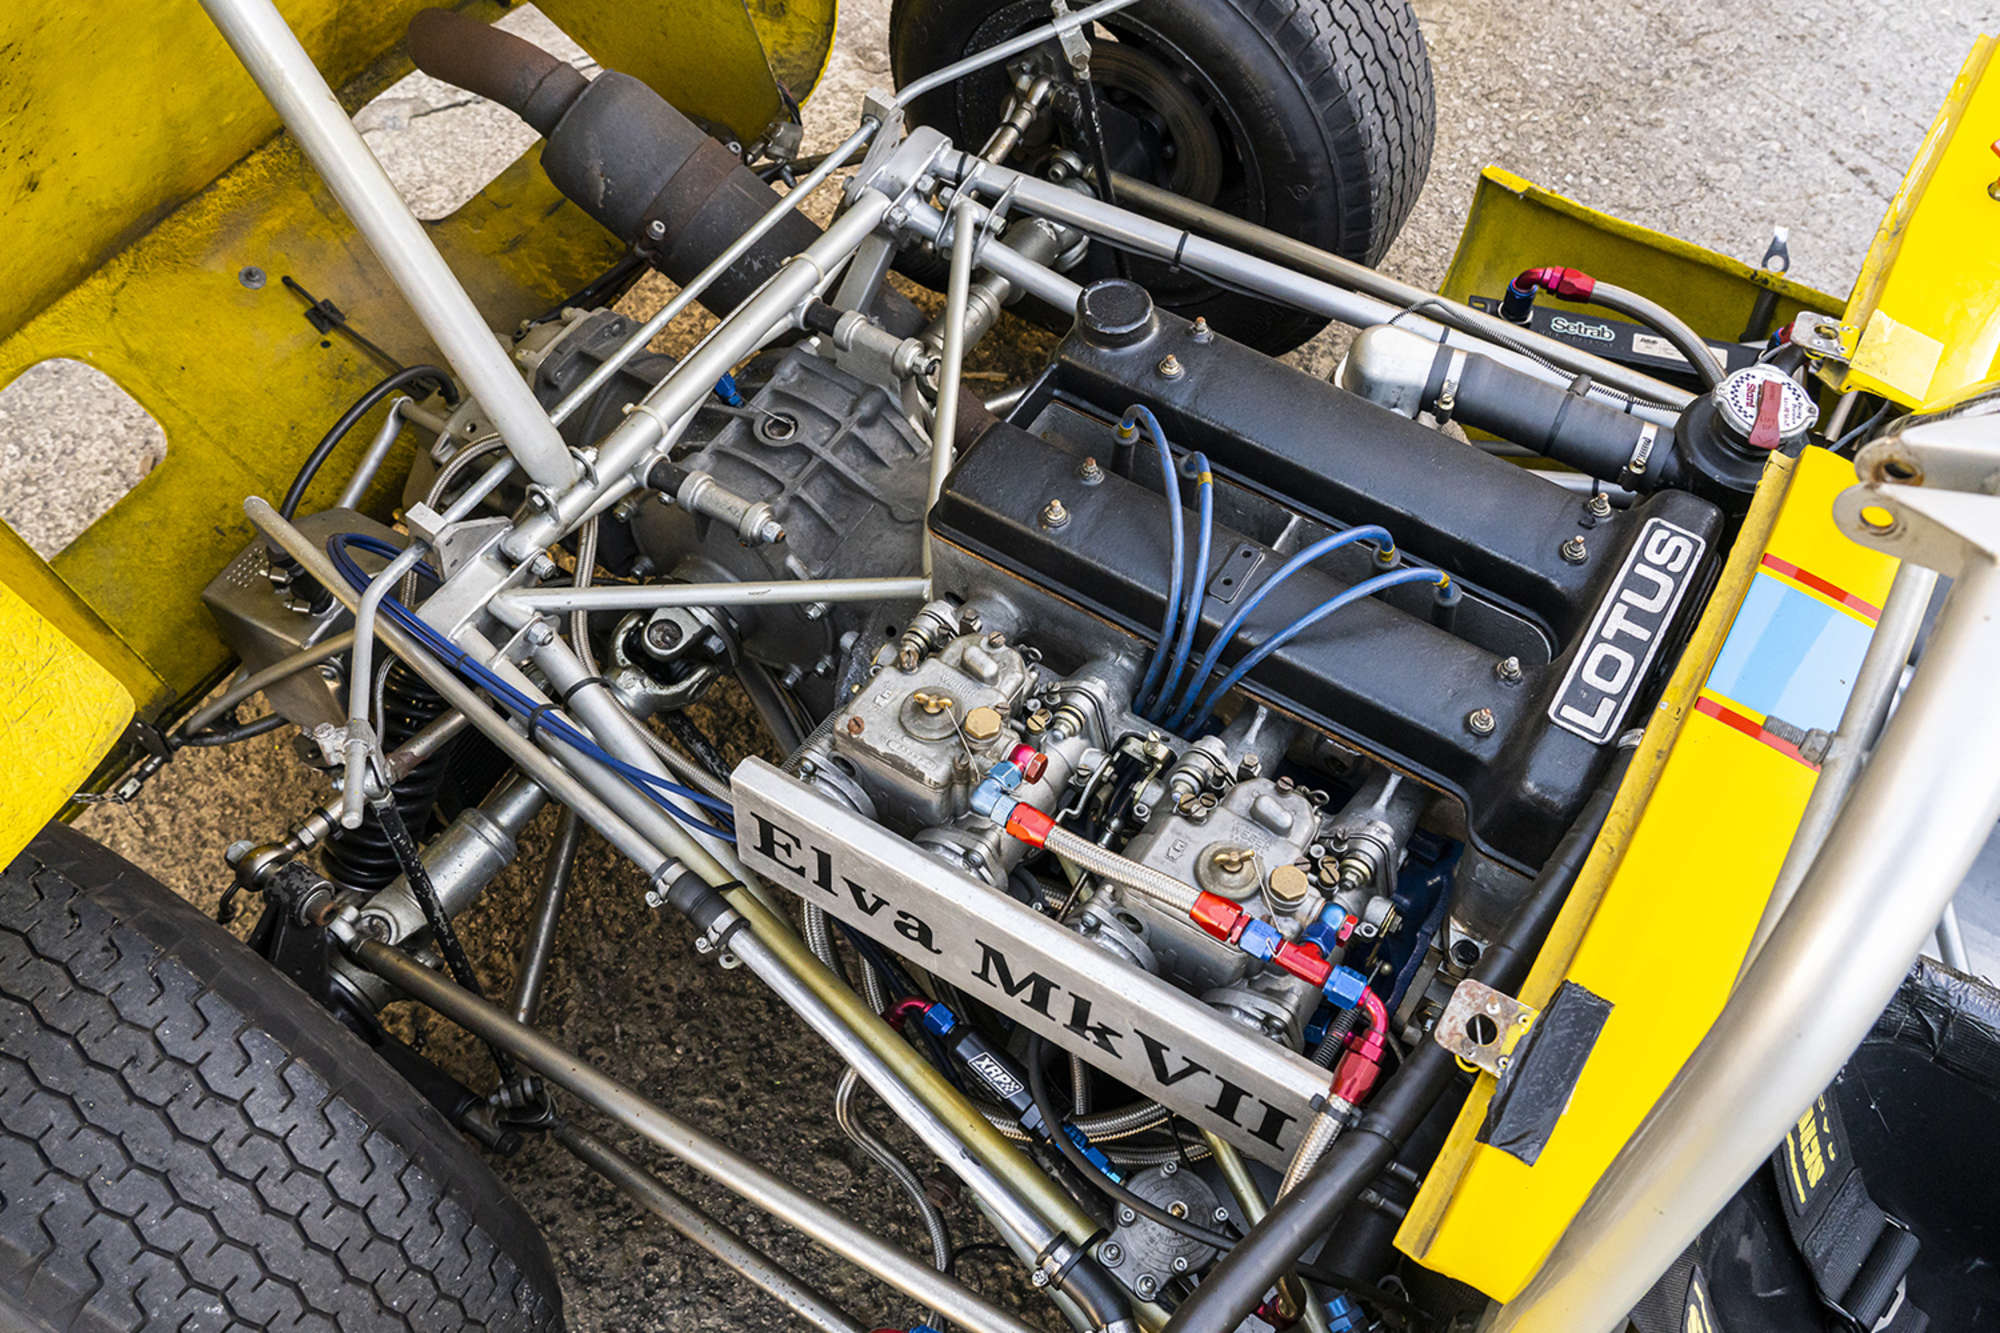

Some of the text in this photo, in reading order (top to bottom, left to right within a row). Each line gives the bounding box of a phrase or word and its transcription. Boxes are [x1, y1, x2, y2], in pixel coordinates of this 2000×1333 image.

[1551, 317, 1615, 342] Setrab
[1559, 528, 1694, 734] LOTUS
[749, 811, 944, 955] Elva
[974, 1057, 1012, 1084] XRP
